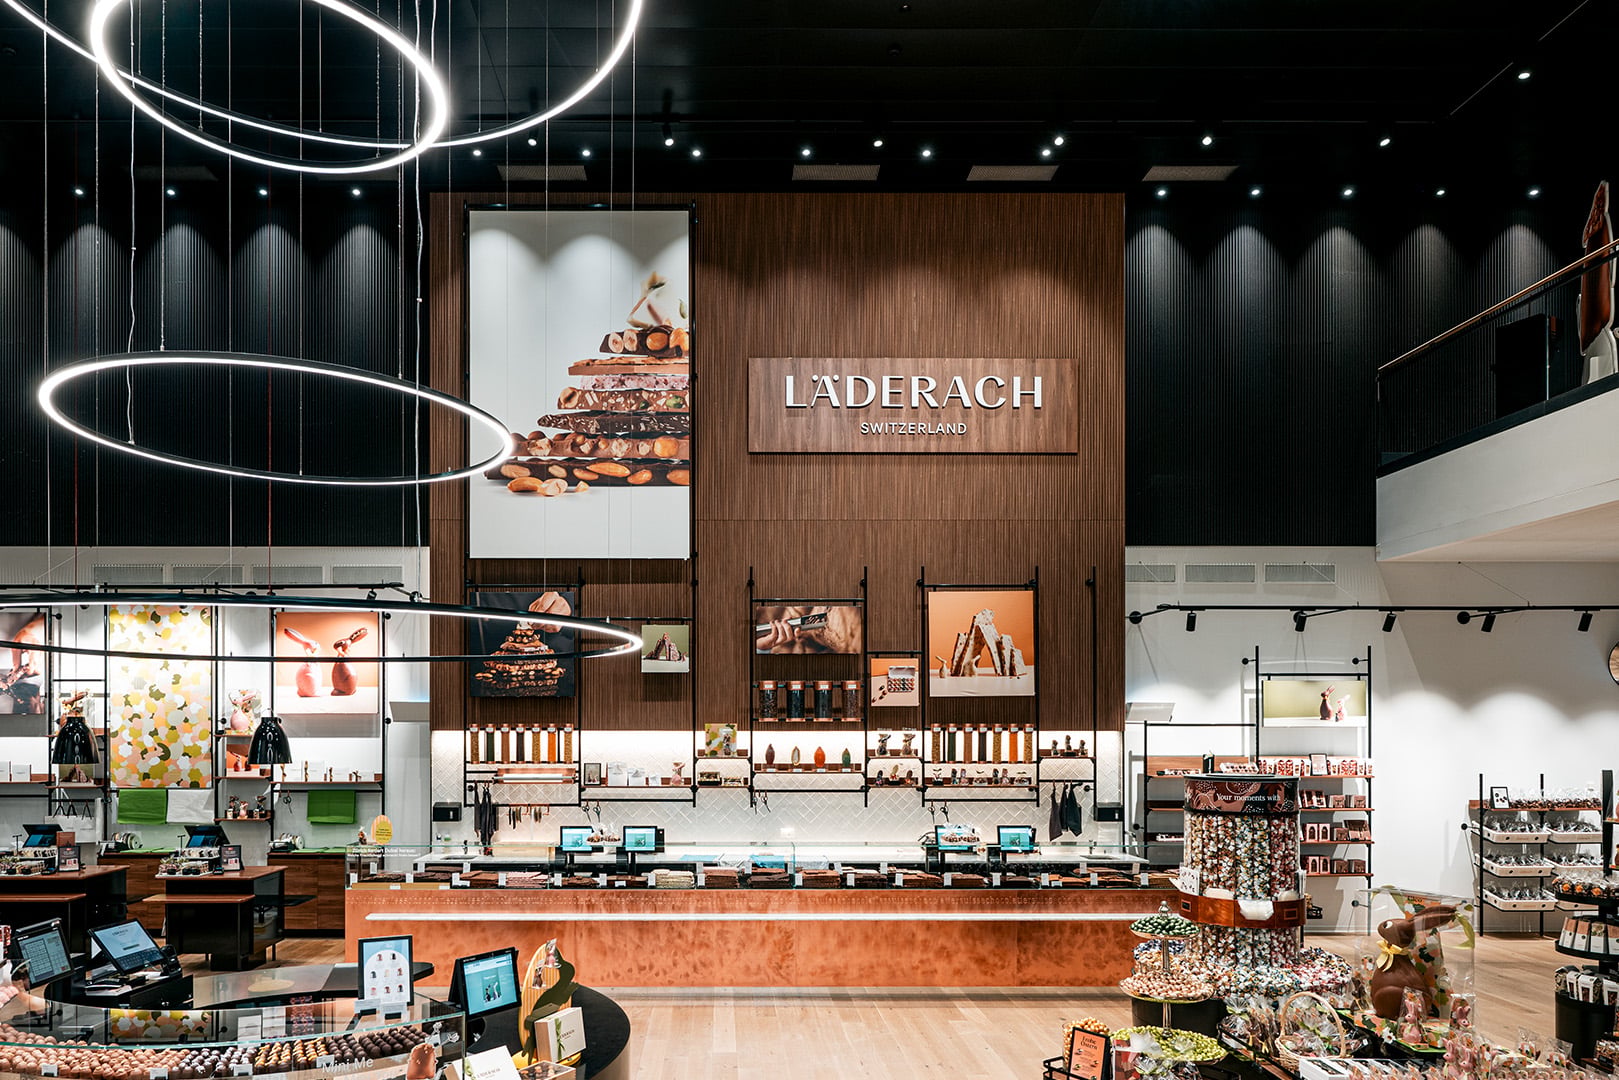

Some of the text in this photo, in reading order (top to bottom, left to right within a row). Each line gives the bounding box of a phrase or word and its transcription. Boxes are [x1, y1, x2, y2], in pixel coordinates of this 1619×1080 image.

[785, 374, 1043, 409] LÄDERACH
[860, 421, 968, 435] SWITZERLAND
[1216, 793, 1281, 801] Your moments with
[322, 1057, 374, 1073] Mini Me
